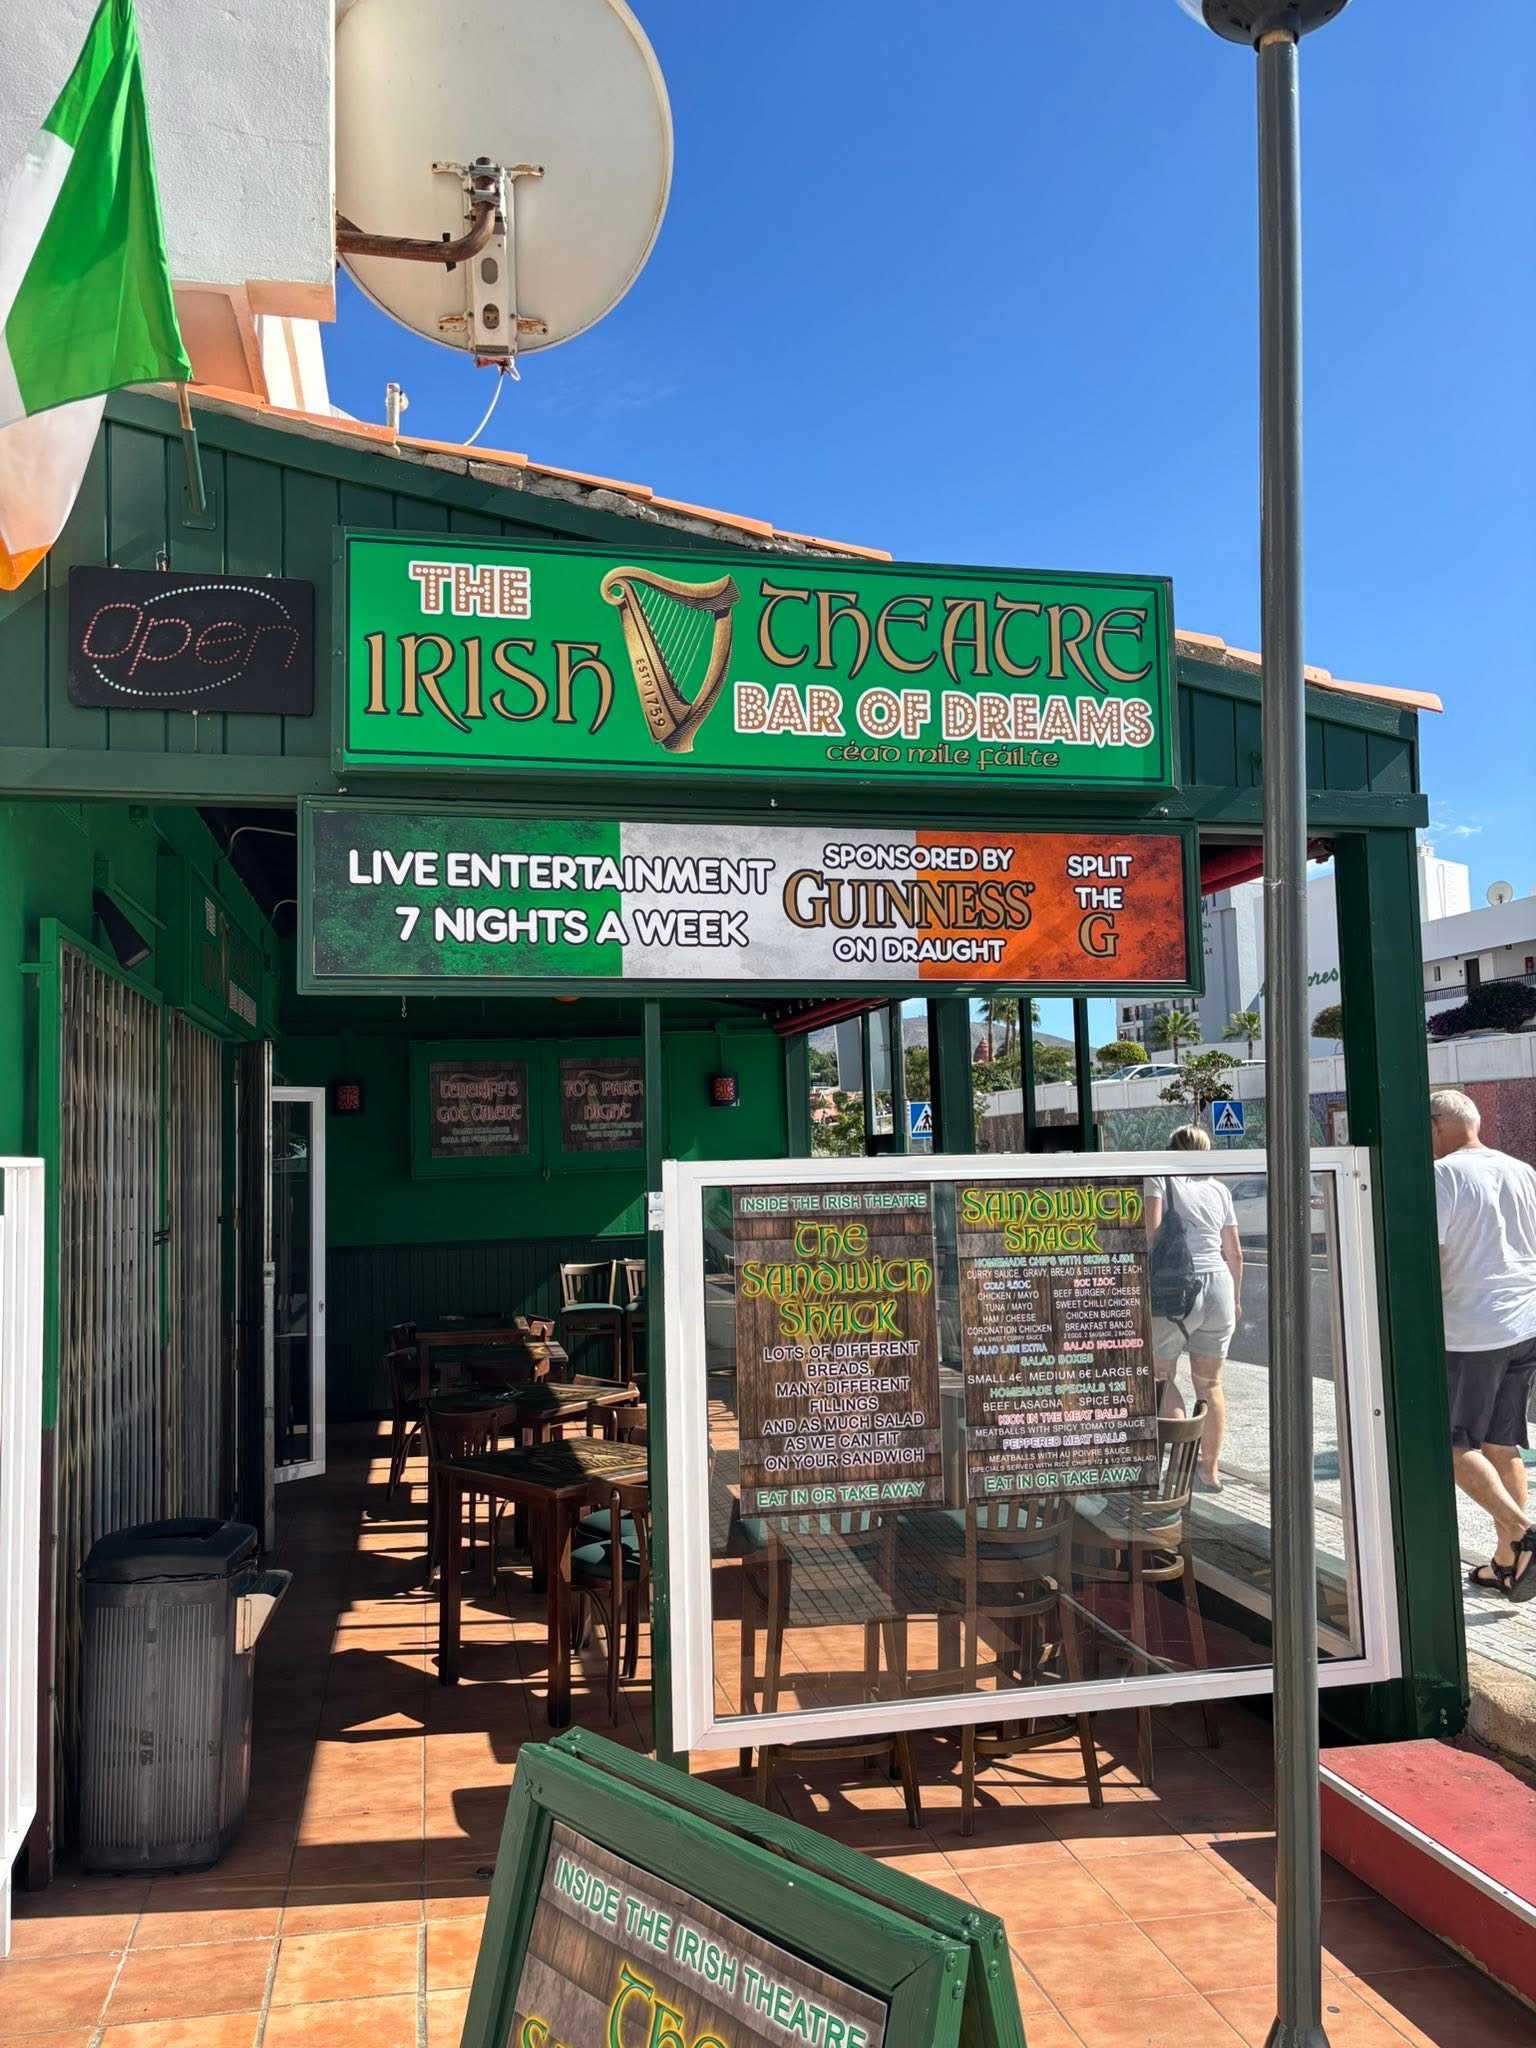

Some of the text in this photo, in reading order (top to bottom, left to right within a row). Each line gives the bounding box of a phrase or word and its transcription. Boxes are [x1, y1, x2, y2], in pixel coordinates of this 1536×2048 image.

[409, 560, 531, 619] THE
[757, 578, 1152, 695] THEATRE
[364, 631, 614, 734] IRISH
[644, 690, 666, 727] 1759
[733, 681, 1154, 748] BAR OF DREAMS
[822, 843, 1014, 873] SPONSORED BY
[1066, 854, 1133, 879] SPLIT
[347, 848, 776, 895] LIVE ENTERTAINMENT
[782, 869, 1035, 931] GUINNESS
[1074, 886, 1123, 910] THE
[394, 905, 750, 949] 7 NIGHTS A WEEK
[1078, 912, 1120, 958] G
[833, 936, 1007, 963] ON DRAUGHT
[741, 1193, 927, 1212] INSIDE THE IRISH THEATRE
[1028, 1256, 1056, 1267] CHIPS
[1057, 1255, 1081, 1266] WITH
[966, 1269, 992, 1280] CURRY
[1050, 1267, 1075, 1277] BREAD
[1076, 1267, 1082, 1276] &
[1083, 1266, 1112, 1275] BUTTER
[1122, 1264, 1143, 1274] EACH
[977, 1291, 1011, 1301] CHICKEN
[1017, 1290, 1039, 1300] MAYO
[1053, 1288, 1073, 1298] BEEF
[1074, 1287, 1106, 1297] BURGER
[1111, 1286, 1141, 1296] CHEESE
[985, 1303, 1006, 1313] TUNA
[1011, 1302, 1033, 1311] MAYO
[1055, 1297, 1141, 1309] SWEET CHILLI CHICKEN
[982, 1314, 1000, 1323] HAM
[1005, 1313, 1037, 1323] CHEESE
[1065, 1309, 1132, 1320] CHICKEN BURGER
[966, 1323, 1052, 1336] CORONATION CHICKEN
[1065, 1320, 1134, 1332] BREAKFAST BANJO
[763, 1341, 919, 1362] LOTS OF DIFFERENT
[972, 1344, 999, 1356] SALAD
[1020, 1343, 1048, 1354] EXTRA
[1063, 1338, 1144, 1351] SALAD INCLUDED
[807, 1362, 874, 1377] BREADS,
[1020, 1353, 1095, 1367] SALAD BOXES
[967, 1366, 1150, 1385] SMALL 4€ MEDIUM 6€ LARGE 8€
[776, 1377, 910, 1398] MANY DIFFERENT
[990, 1384, 1053, 1398] HOMEMADE
[1054, 1382, 1106, 1395] SPECIALS
[809, 1398, 878, 1414] FILLINGS
[983, 1401, 1010, 1412] BEEF
[1013, 1398, 1064, 1411] LASAGNA
[1078, 1395, 1110, 1407] SPICE
[1112, 1394, 1134, 1405] BAG
[763, 1413, 924, 1435] AND AS MUCH SALAD
[997, 1407, 1128, 1426] KICK IN THE MEAT BALLS
[975, 1419, 1145, 1437] MEATBALLS WITH SPICY TOMATO SAUCE
[785, 1432, 900, 1451] AS WE CAN FIT
[1002, 1431, 1128, 1451] PEPPERED MEAT BALLS
[765, 1449, 925, 1471] ON YOUR SANDWICH
[989, 1446, 1131, 1463] MEATBALLS WITH AU POIVRE SAUCE
[984, 1466, 1142, 1493] EAT IN OR TAKE AWAY
[757, 1482, 925, 1507] EAT IN OR TAKE AWAY
[553, 1855, 869, 2048] INSIDE THE IRISH THEATRE
